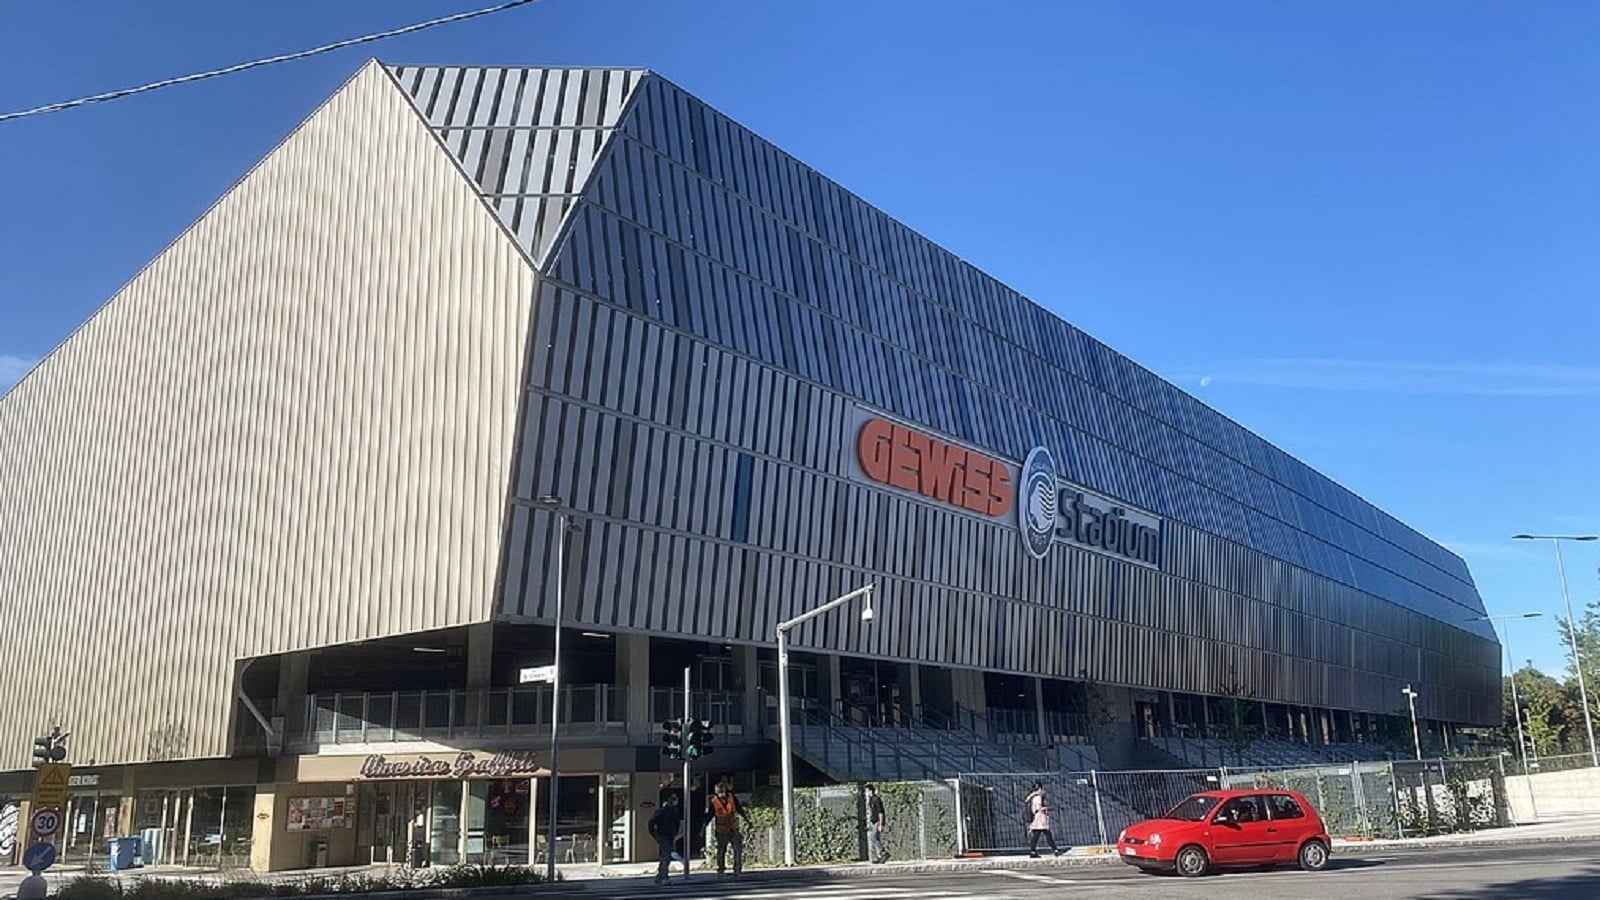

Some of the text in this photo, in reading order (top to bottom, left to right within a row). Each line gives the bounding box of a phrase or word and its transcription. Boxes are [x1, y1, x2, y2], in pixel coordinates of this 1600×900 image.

[1056, 487, 1158, 565] Stadium
[360, 752, 539, 778] America Graffiti
[39, 815, 55, 829] 30
